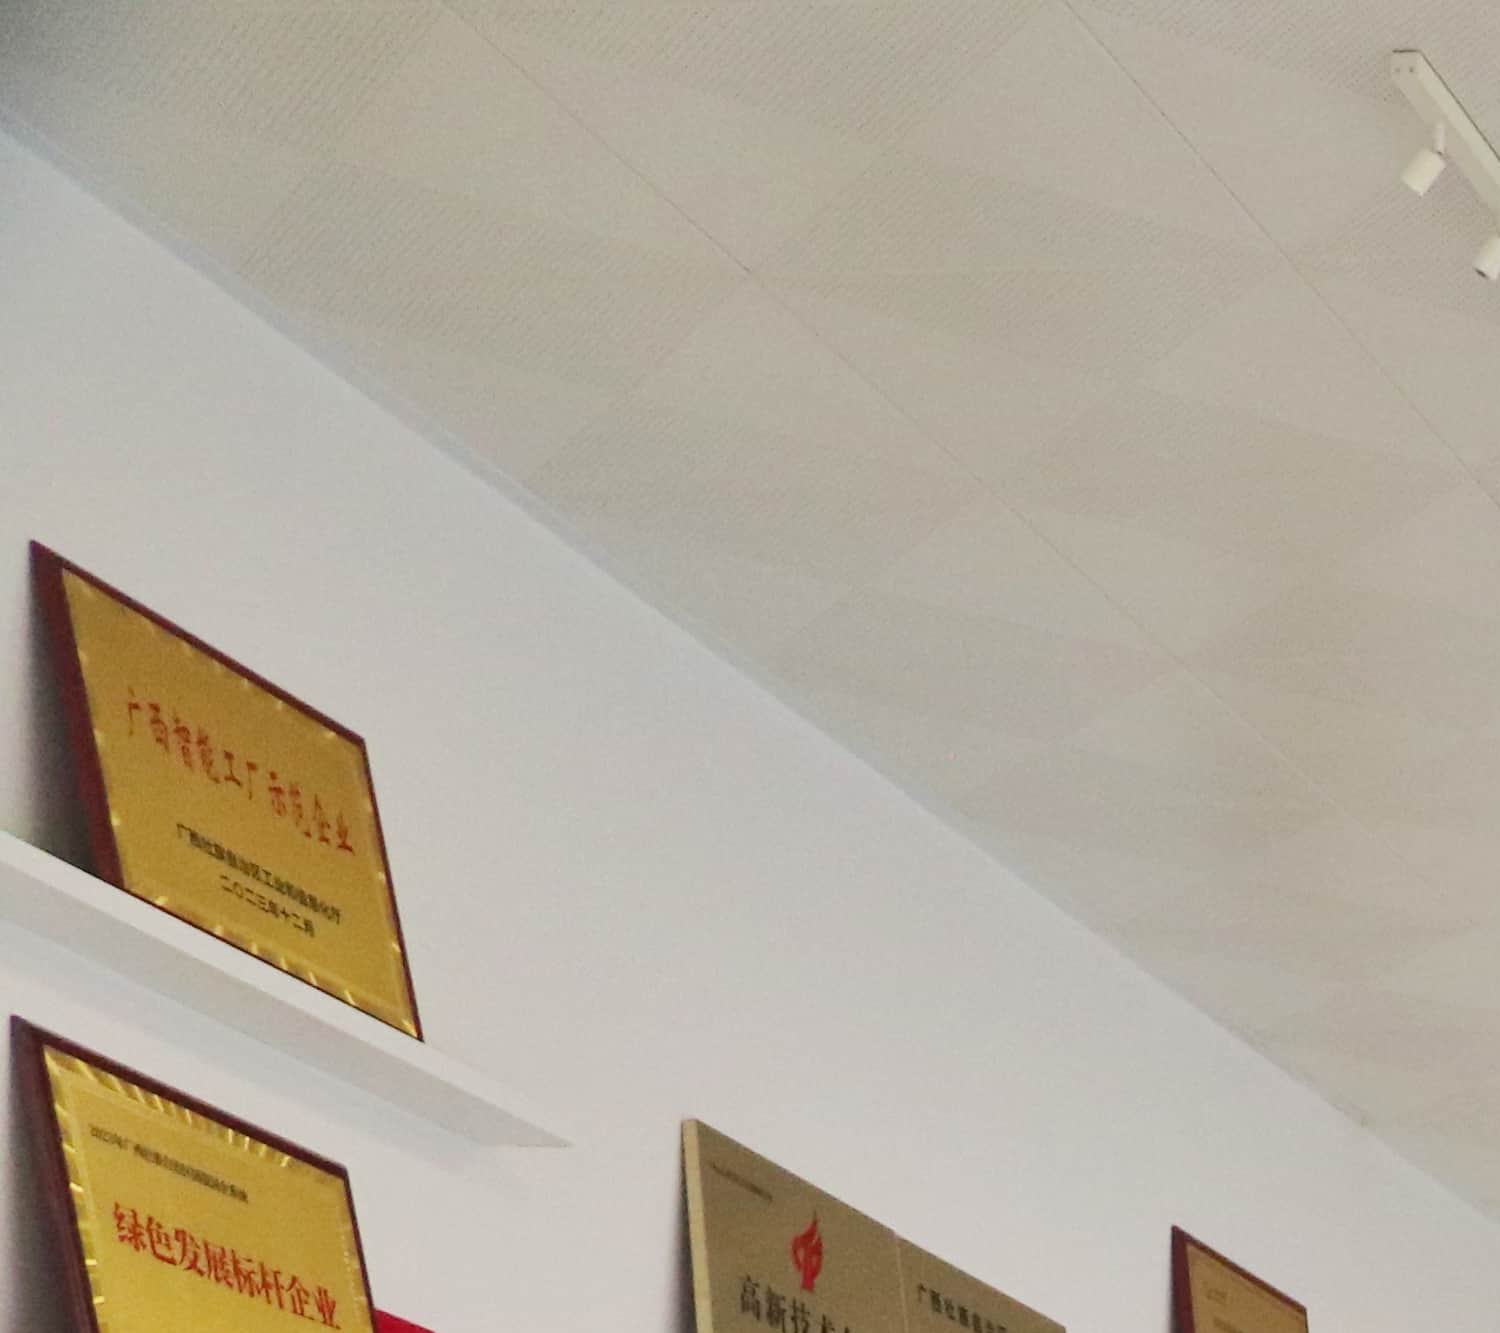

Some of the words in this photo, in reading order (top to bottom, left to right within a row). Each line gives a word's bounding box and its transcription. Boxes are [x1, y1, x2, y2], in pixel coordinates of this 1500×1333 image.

[113, 1202, 342, 1331] 绿色发展标杆企业
